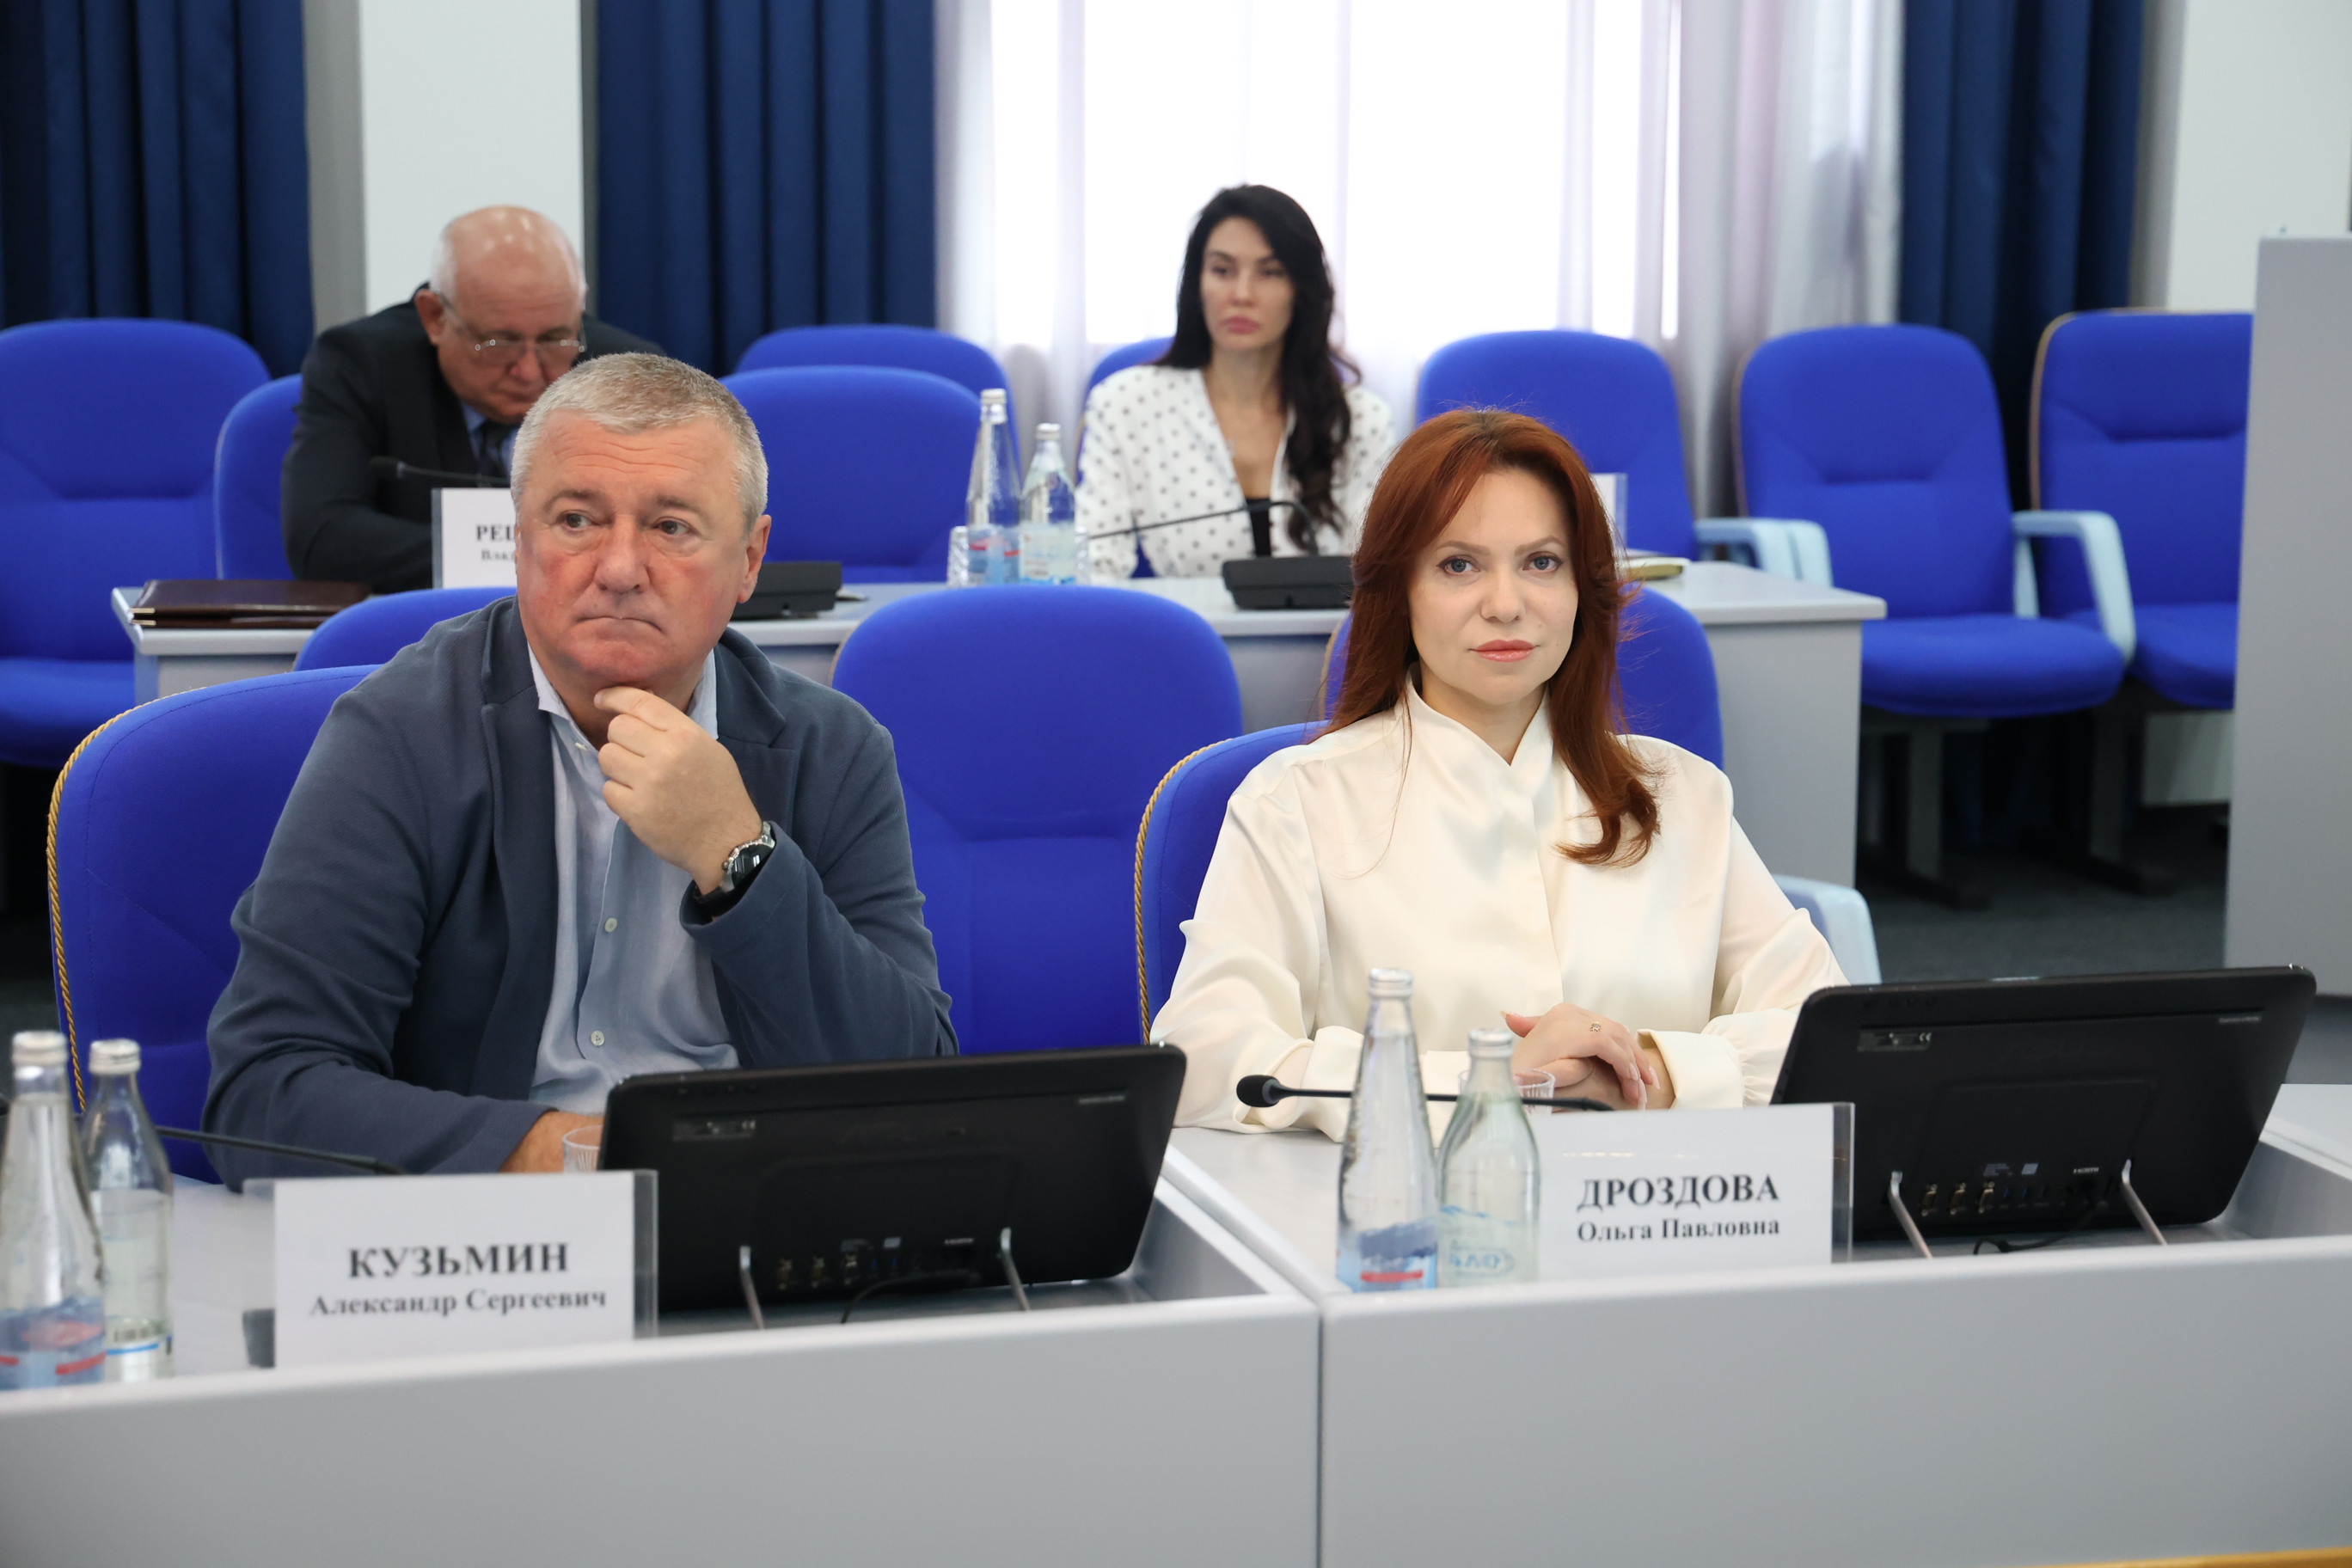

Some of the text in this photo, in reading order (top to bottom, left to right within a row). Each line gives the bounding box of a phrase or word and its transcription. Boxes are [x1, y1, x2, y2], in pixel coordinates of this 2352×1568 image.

[1577, 1174, 1779, 1212] ДРОЗДОВА
[1577, 1218, 1780, 1242] Ольга Павловна
[348, 1243, 569, 1278] КУЗЬМИН
[310, 1289, 607, 1317] Александр Сергеевич
